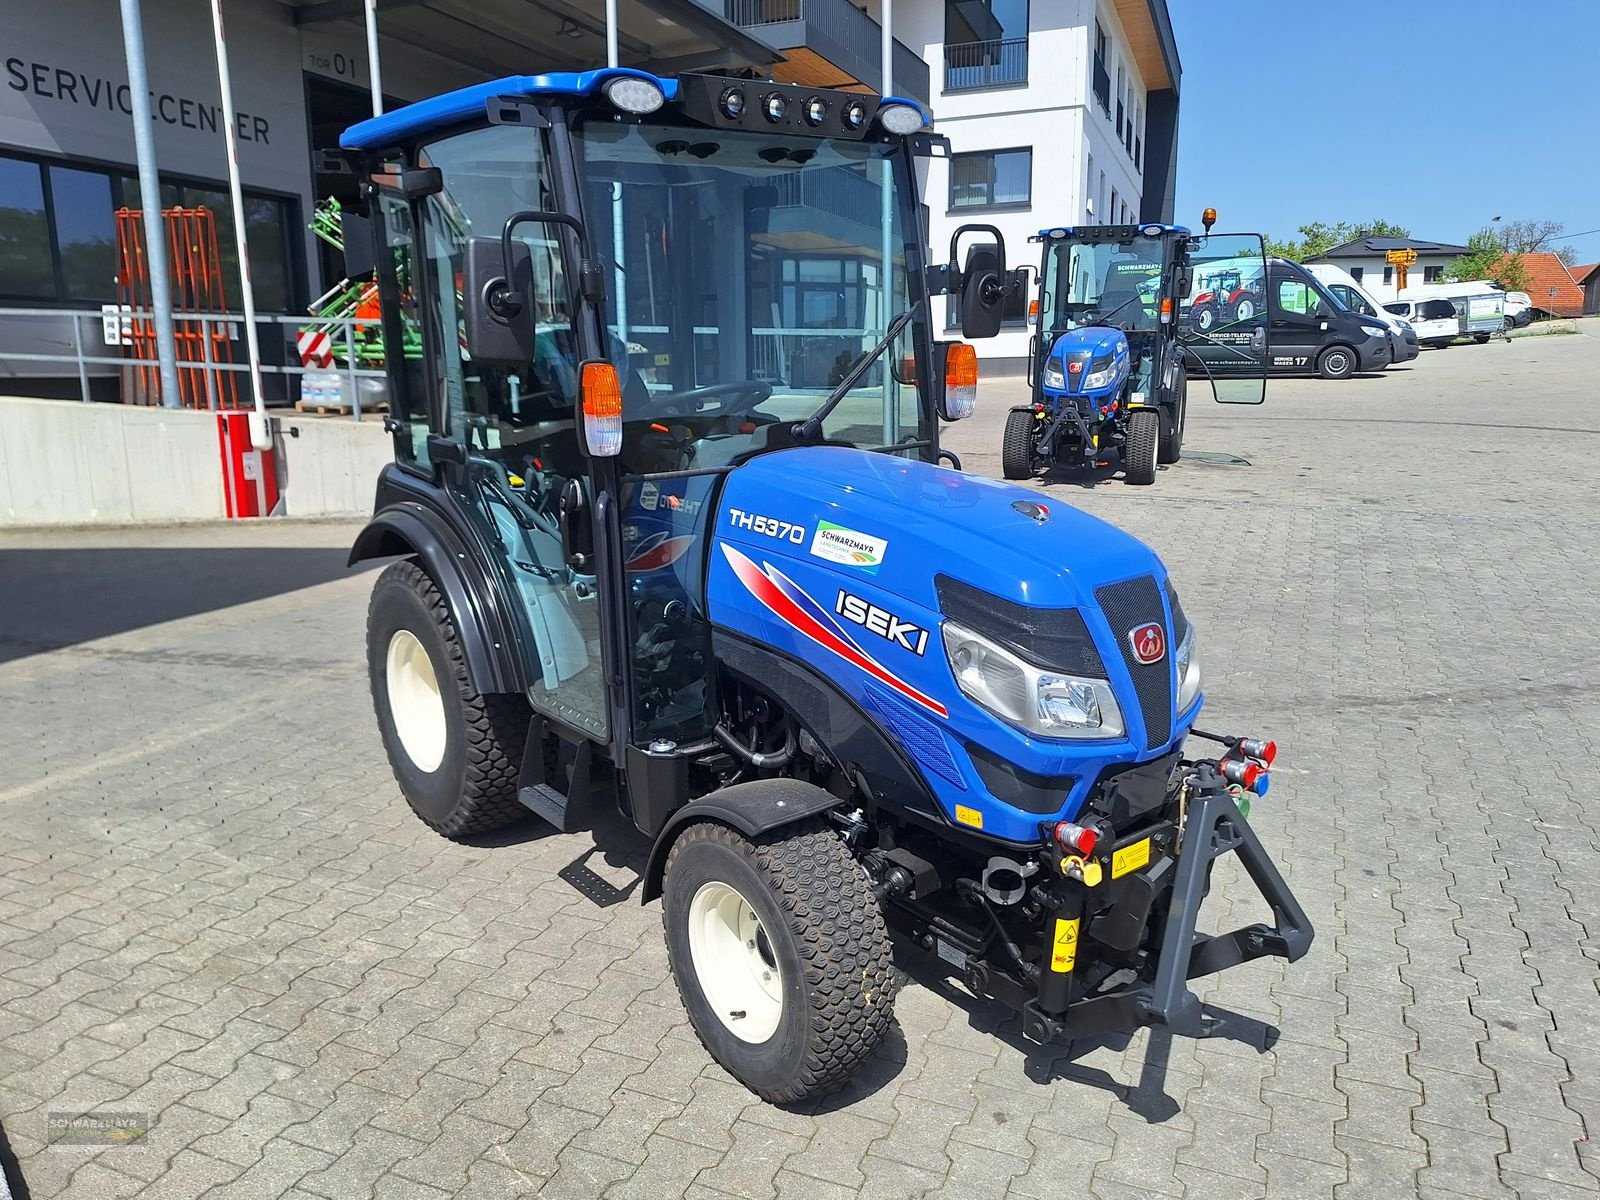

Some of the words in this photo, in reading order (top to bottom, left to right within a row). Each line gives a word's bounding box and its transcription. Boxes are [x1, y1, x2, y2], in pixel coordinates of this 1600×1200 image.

[333, 53, 356, 79] 01
[5, 57, 270, 145] SERVICCENER
[1295, 356, 1308, 366] 17
[728, 508, 805, 545] TH5370
[821, 530, 874, 553] SCHWARZMAYR
[834, 587, 931, 657] ISEKI
